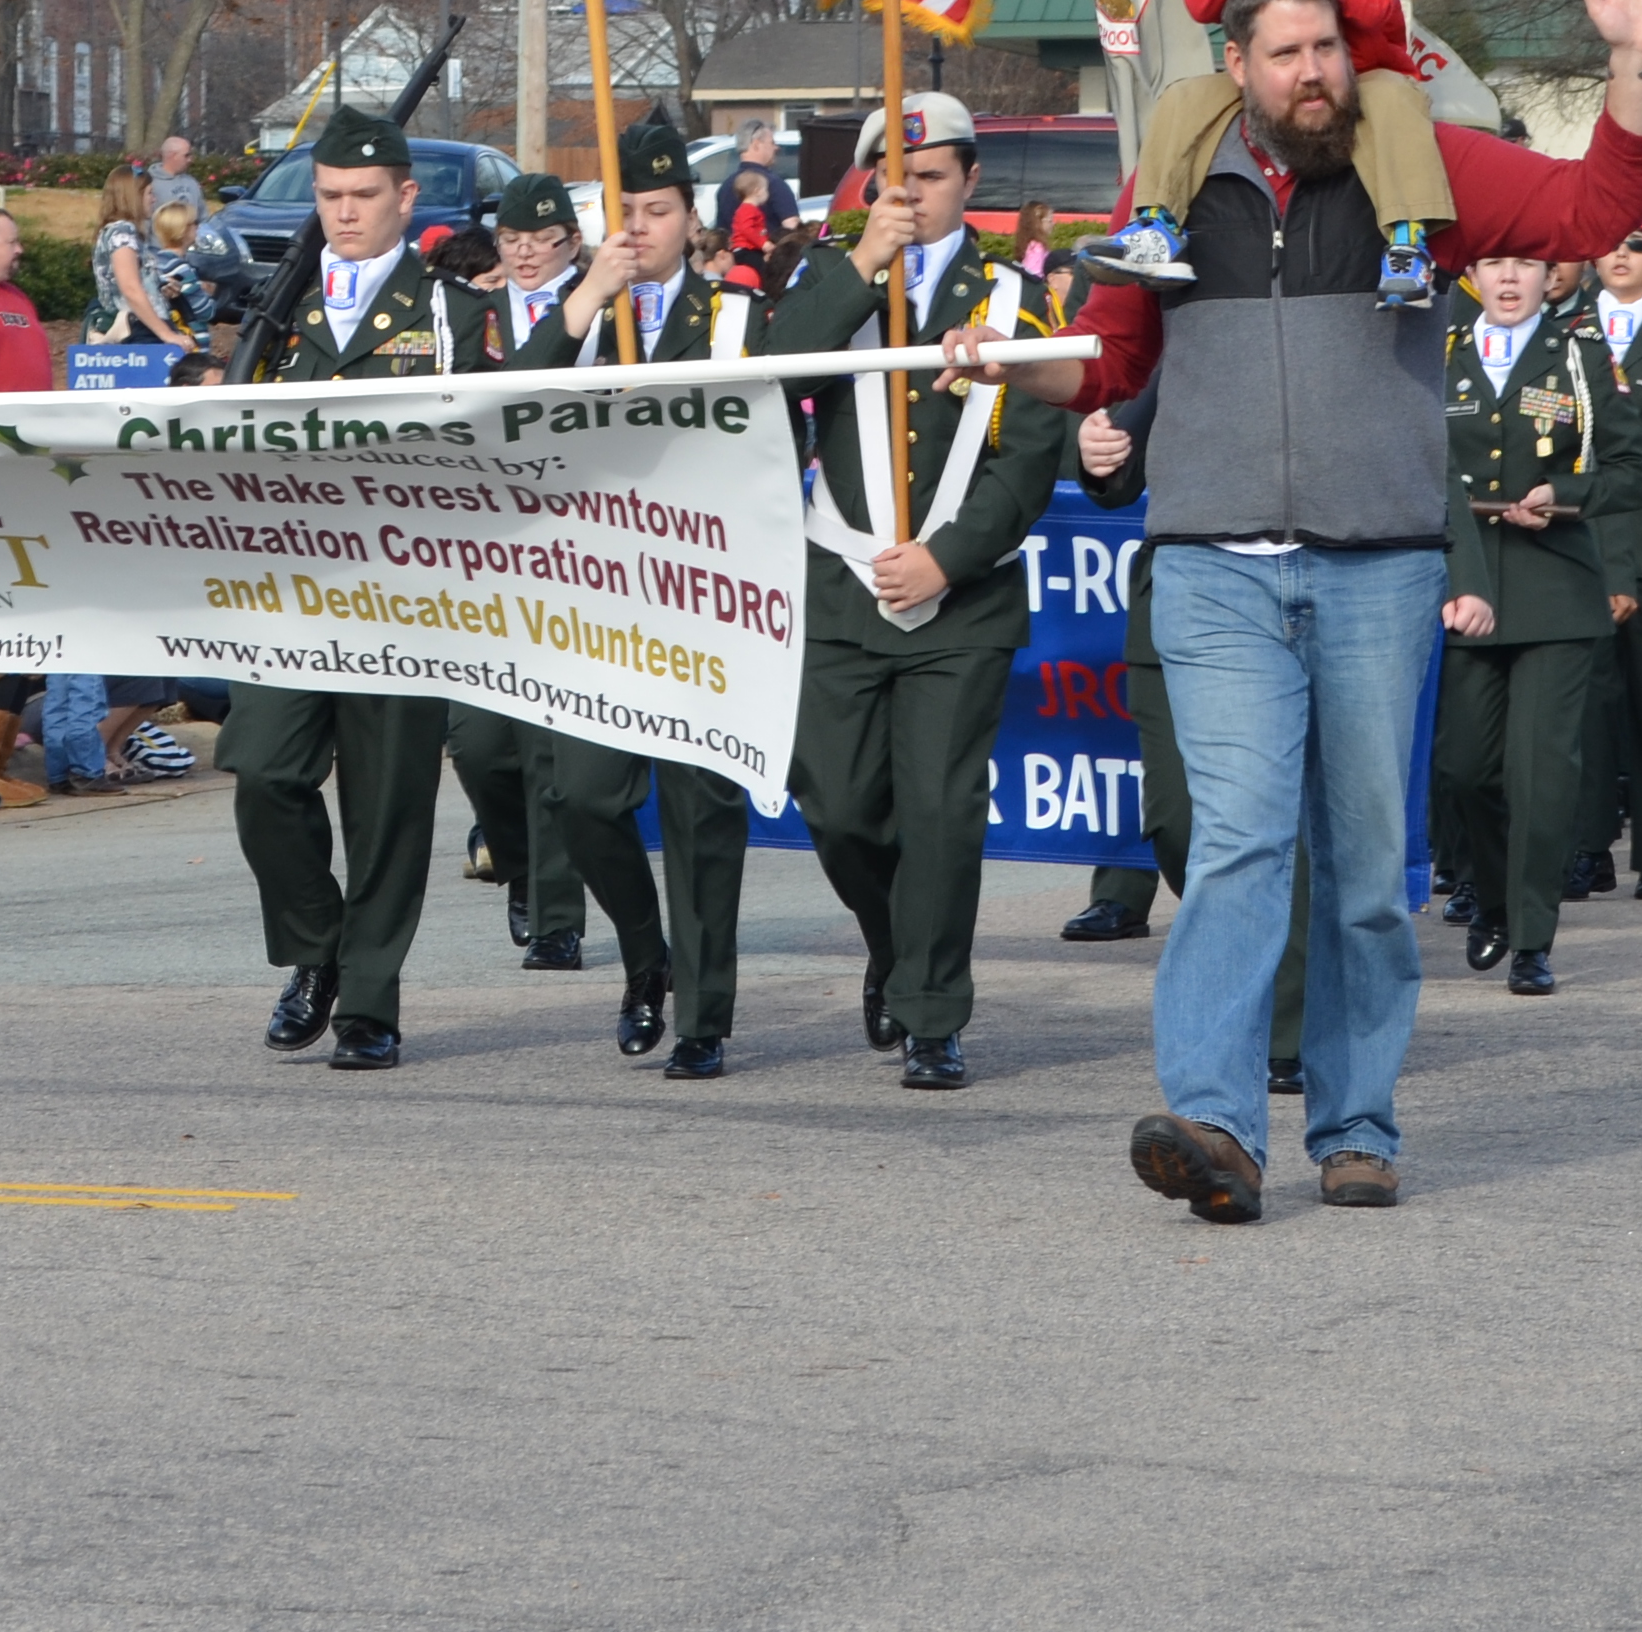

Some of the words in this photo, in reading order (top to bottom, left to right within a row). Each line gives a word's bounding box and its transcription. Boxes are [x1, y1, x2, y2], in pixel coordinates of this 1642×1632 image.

[74, 353, 147, 367] Drive-In
[74, 374, 115, 389] ATM
[117, 407, 476, 453] Christmas
[501, 387, 750, 444] Parade
[489, 456, 566, 480] by:
[121, 472, 215, 501] The
[217, 472, 346, 505] Wake
[353, 475, 501, 512] Forest
[505, 483, 727, 552] Downtown
[70, 511, 369, 562] Revitalization
[379, 524, 629, 596] Corporation
[639, 551, 793, 649] (WFDRC)
[203, 572, 284, 613] and
[291, 573, 509, 638] Dedicated
[515, 595, 727, 695] Volunteers
[157, 634, 767, 779] www.wakeforestdowntown.com
